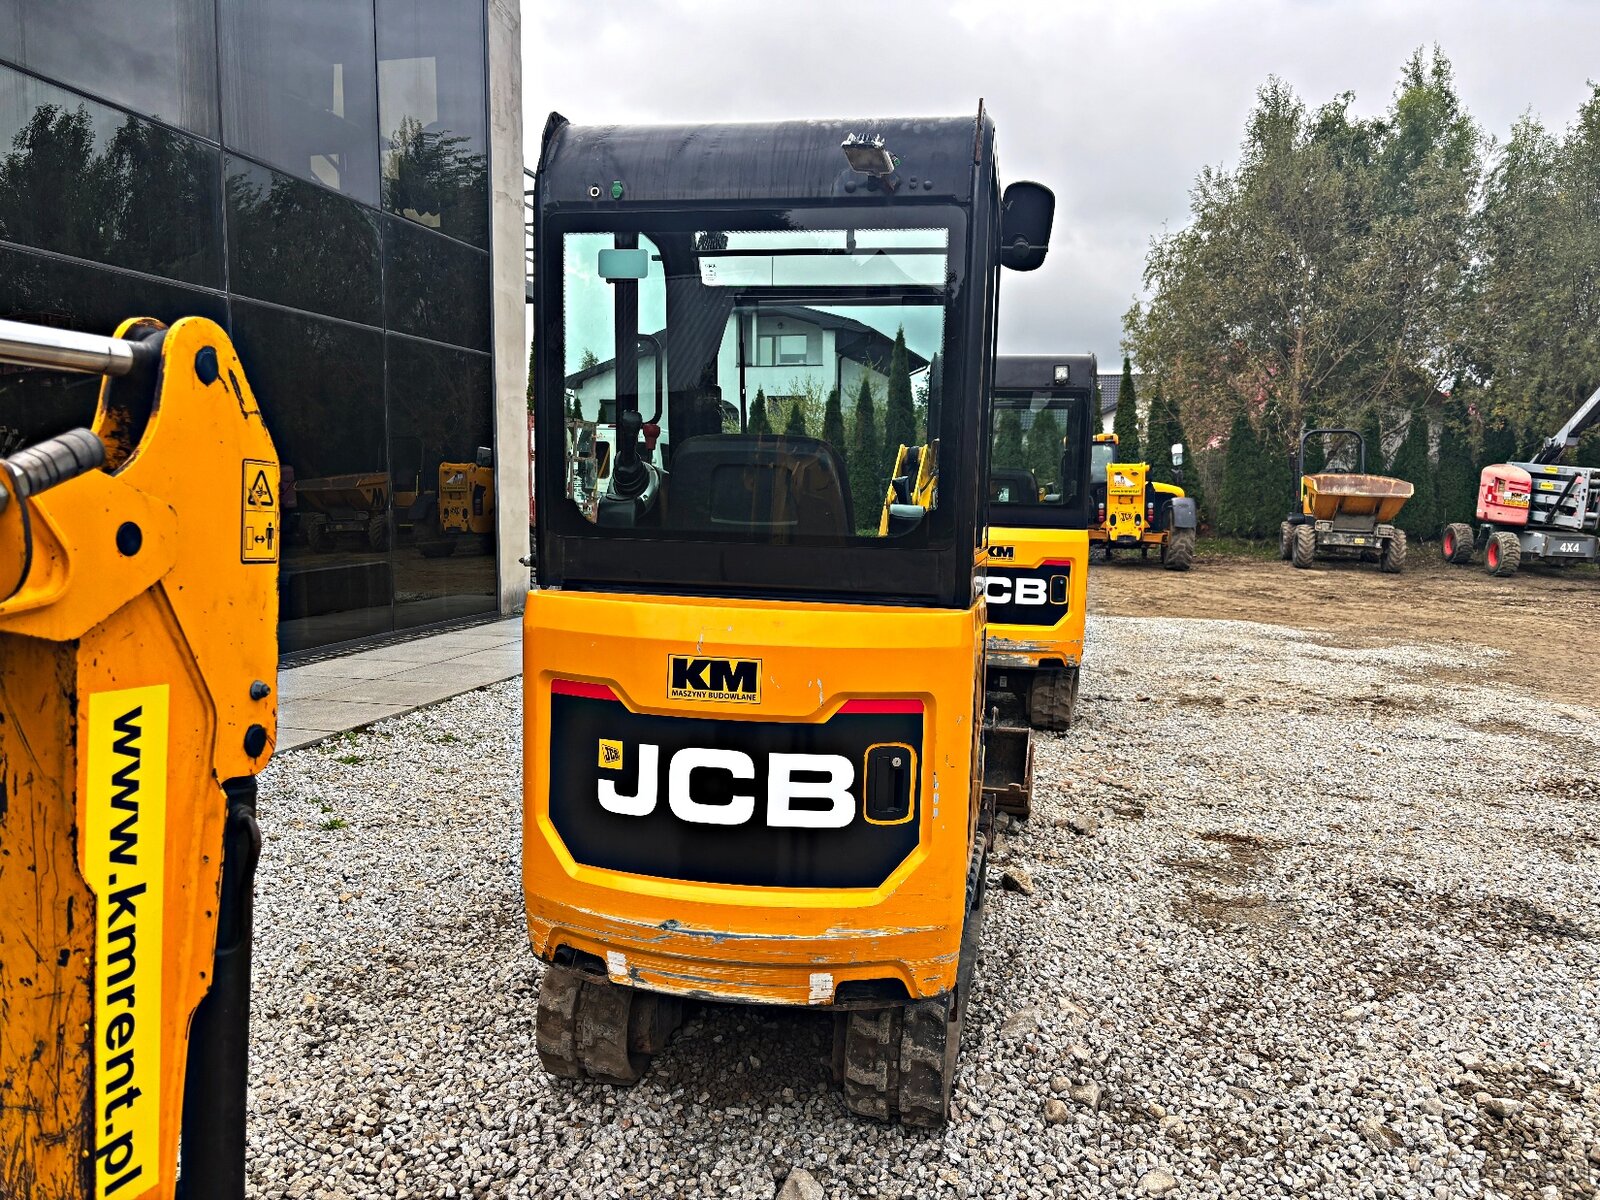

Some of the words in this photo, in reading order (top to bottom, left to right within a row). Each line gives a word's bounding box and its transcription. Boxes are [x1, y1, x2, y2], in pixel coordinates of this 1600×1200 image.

[1559, 542, 1580, 553] 4X4
[985, 575, 1048, 606] CB
[672, 658, 758, 693] KM
[671, 689, 707, 699] MASZYNY
[708, 691, 757, 702] BUDOWLANE
[604, 746, 621, 761] JCB
[597, 743, 856, 828] JCB
[96, 705, 147, 1197] www.kmrent.pl
